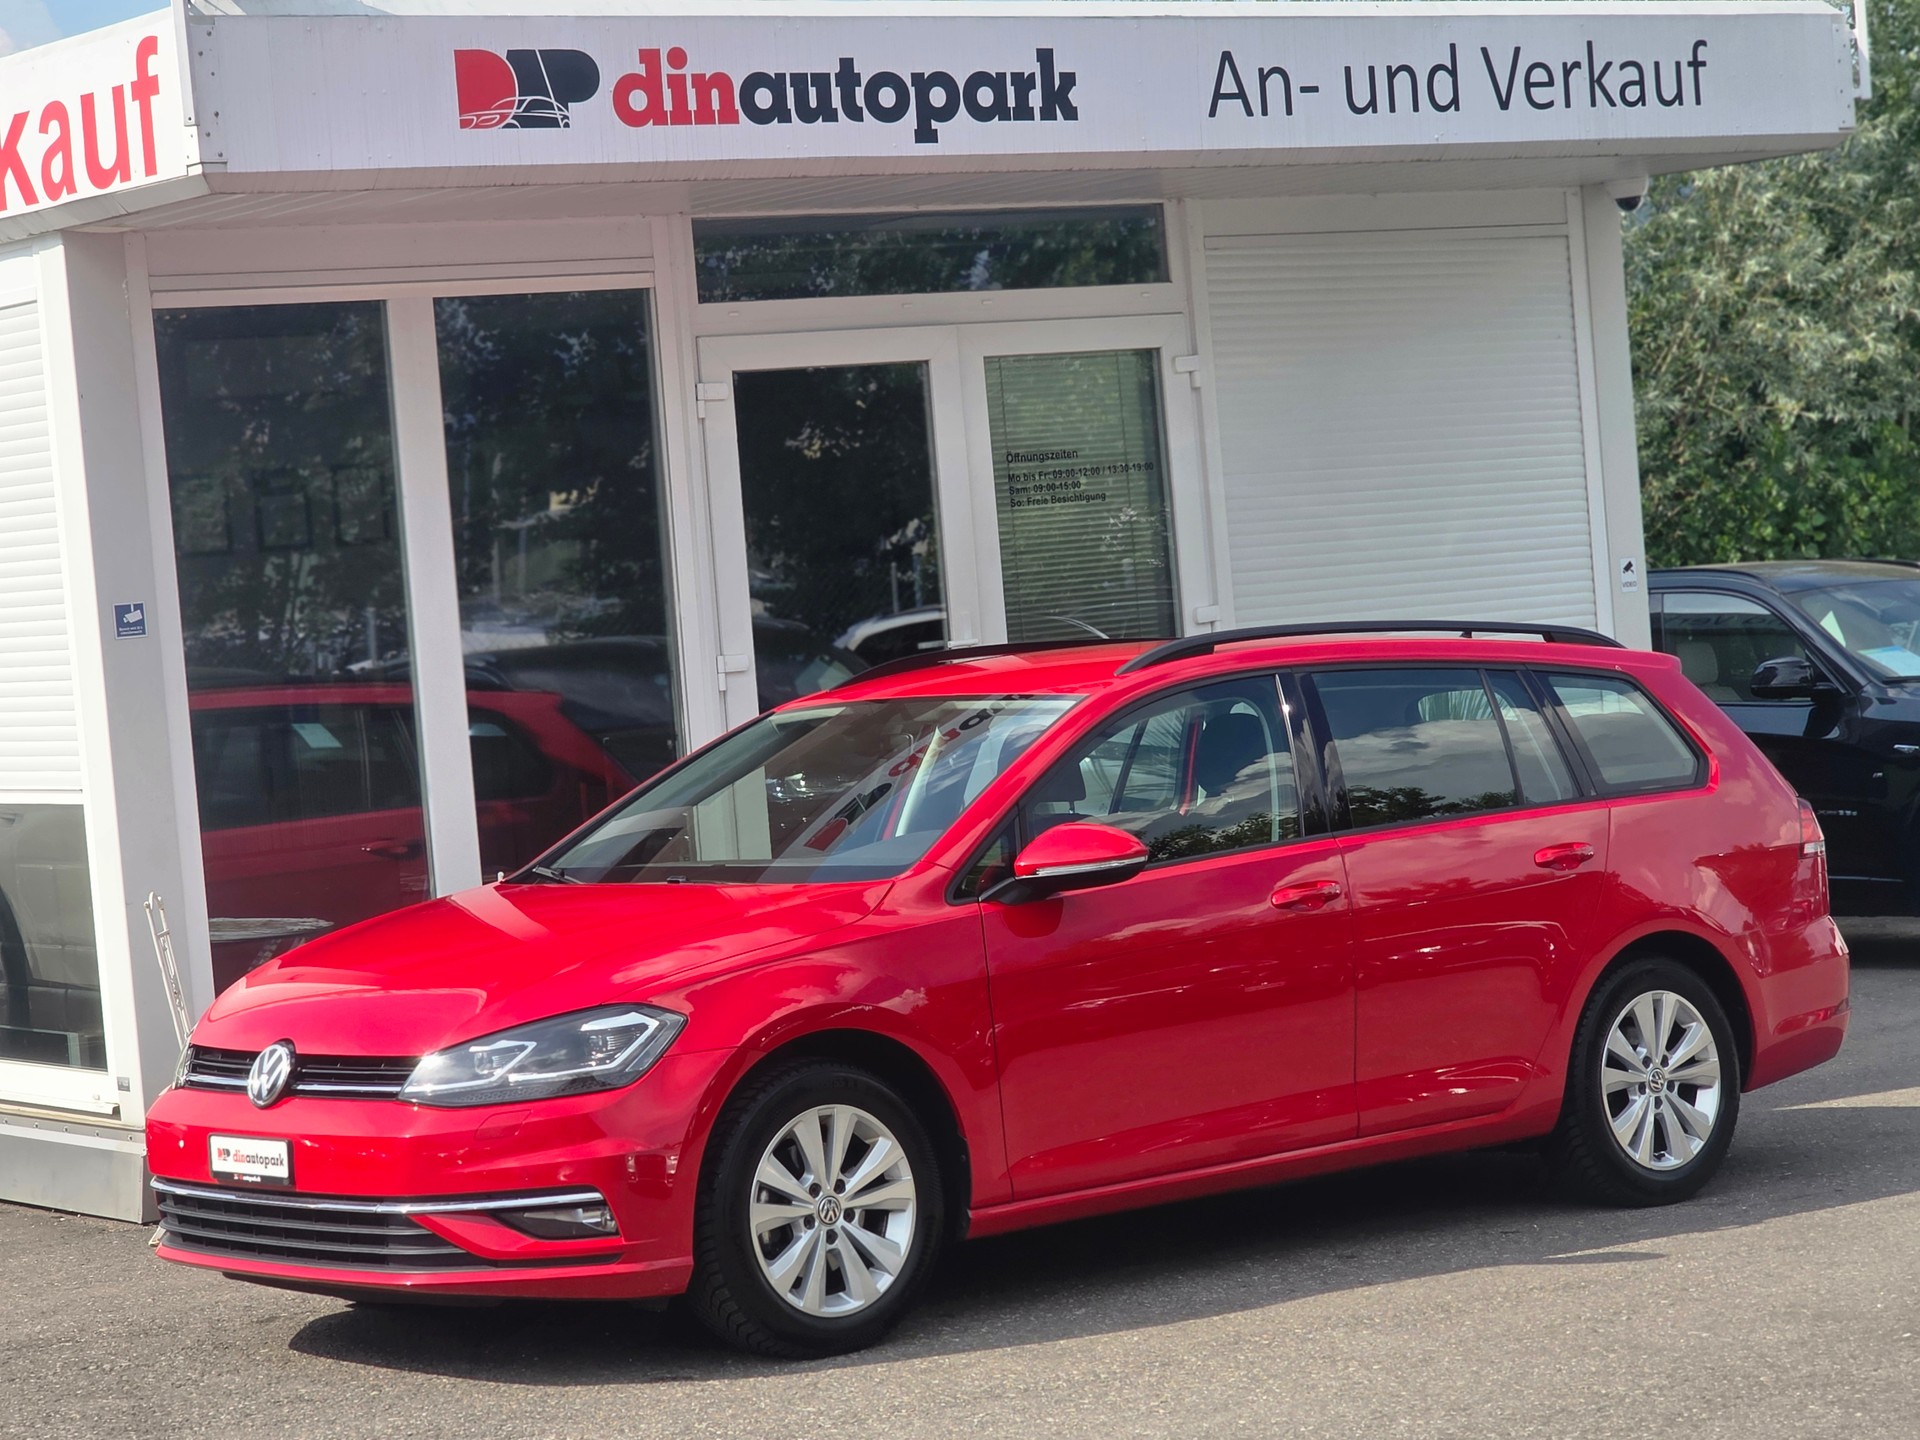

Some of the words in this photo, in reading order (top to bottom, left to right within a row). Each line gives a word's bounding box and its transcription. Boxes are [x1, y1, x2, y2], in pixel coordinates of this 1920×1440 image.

[1207, 49, 1320, 118] An-
[1343, 42, 1461, 115] und
[1480, 39, 1708, 111] Verkauf
[612, 47, 1079, 143] dinautopark
[1006, 449, 1079, 463] Öffnungszeiten
[1008, 473, 1021, 483] Mo
[1023, 472, 1036, 481] bis
[1052, 467, 1101, 479] 09:00-12:00
[1108, 462, 1154, 475] 13:30-19:00
[1009, 486, 1031, 496] Sam:
[1033, 480, 1081, 493] 09:00-15:00
[1010, 498, 1024, 508] So:
[1027, 496, 1049, 506] Freie
[1051, 492, 1106, 504] Besichtigung
[233, 1149, 285, 1169] dinautopark
